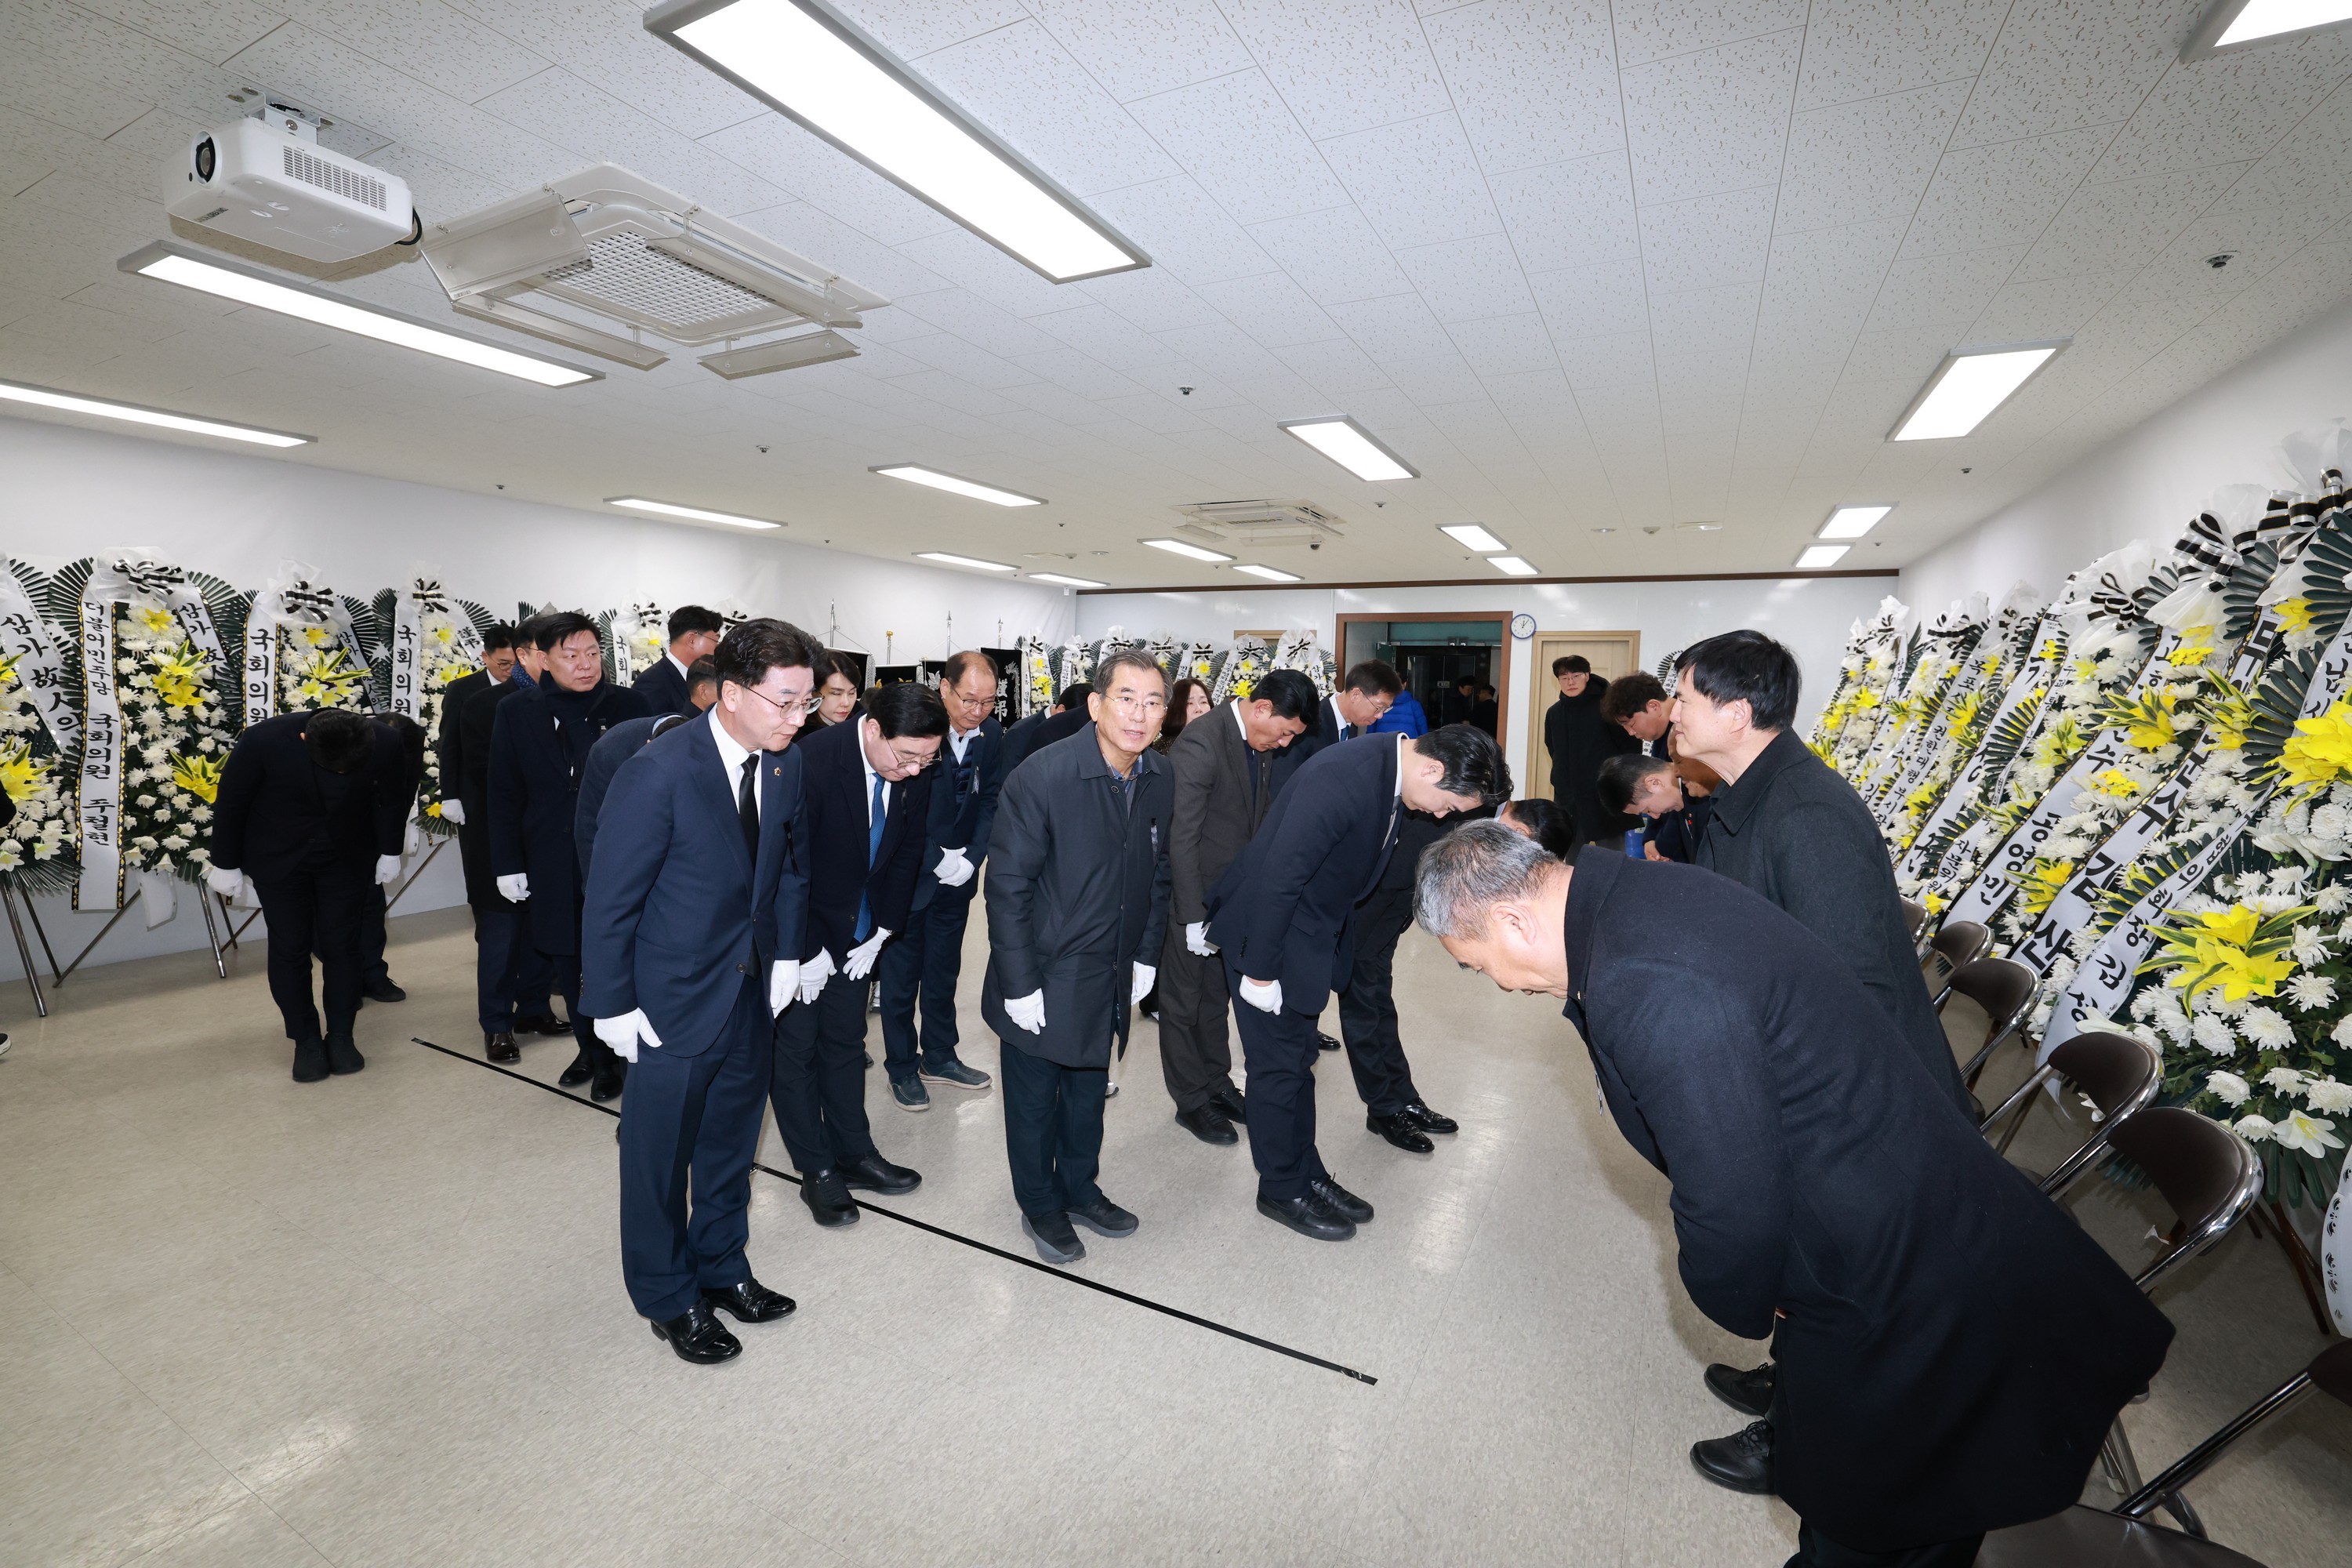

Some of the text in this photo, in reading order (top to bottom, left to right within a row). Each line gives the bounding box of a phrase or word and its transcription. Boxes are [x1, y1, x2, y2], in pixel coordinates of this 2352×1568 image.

[178, 602, 212, 636] 삼가
[339, 631, 359, 656] 삼가
[1, 613, 83, 731] 삼가 故人의
[249, 628, 274, 722] 국회의원
[394, 625, 417, 715] 국회의원
[82, 600, 119, 848] 더불어민주당 국회의원 주철현
[1907, 725, 1947, 785] 권한대행
[1875, 786, 1907, 829] 부시장
